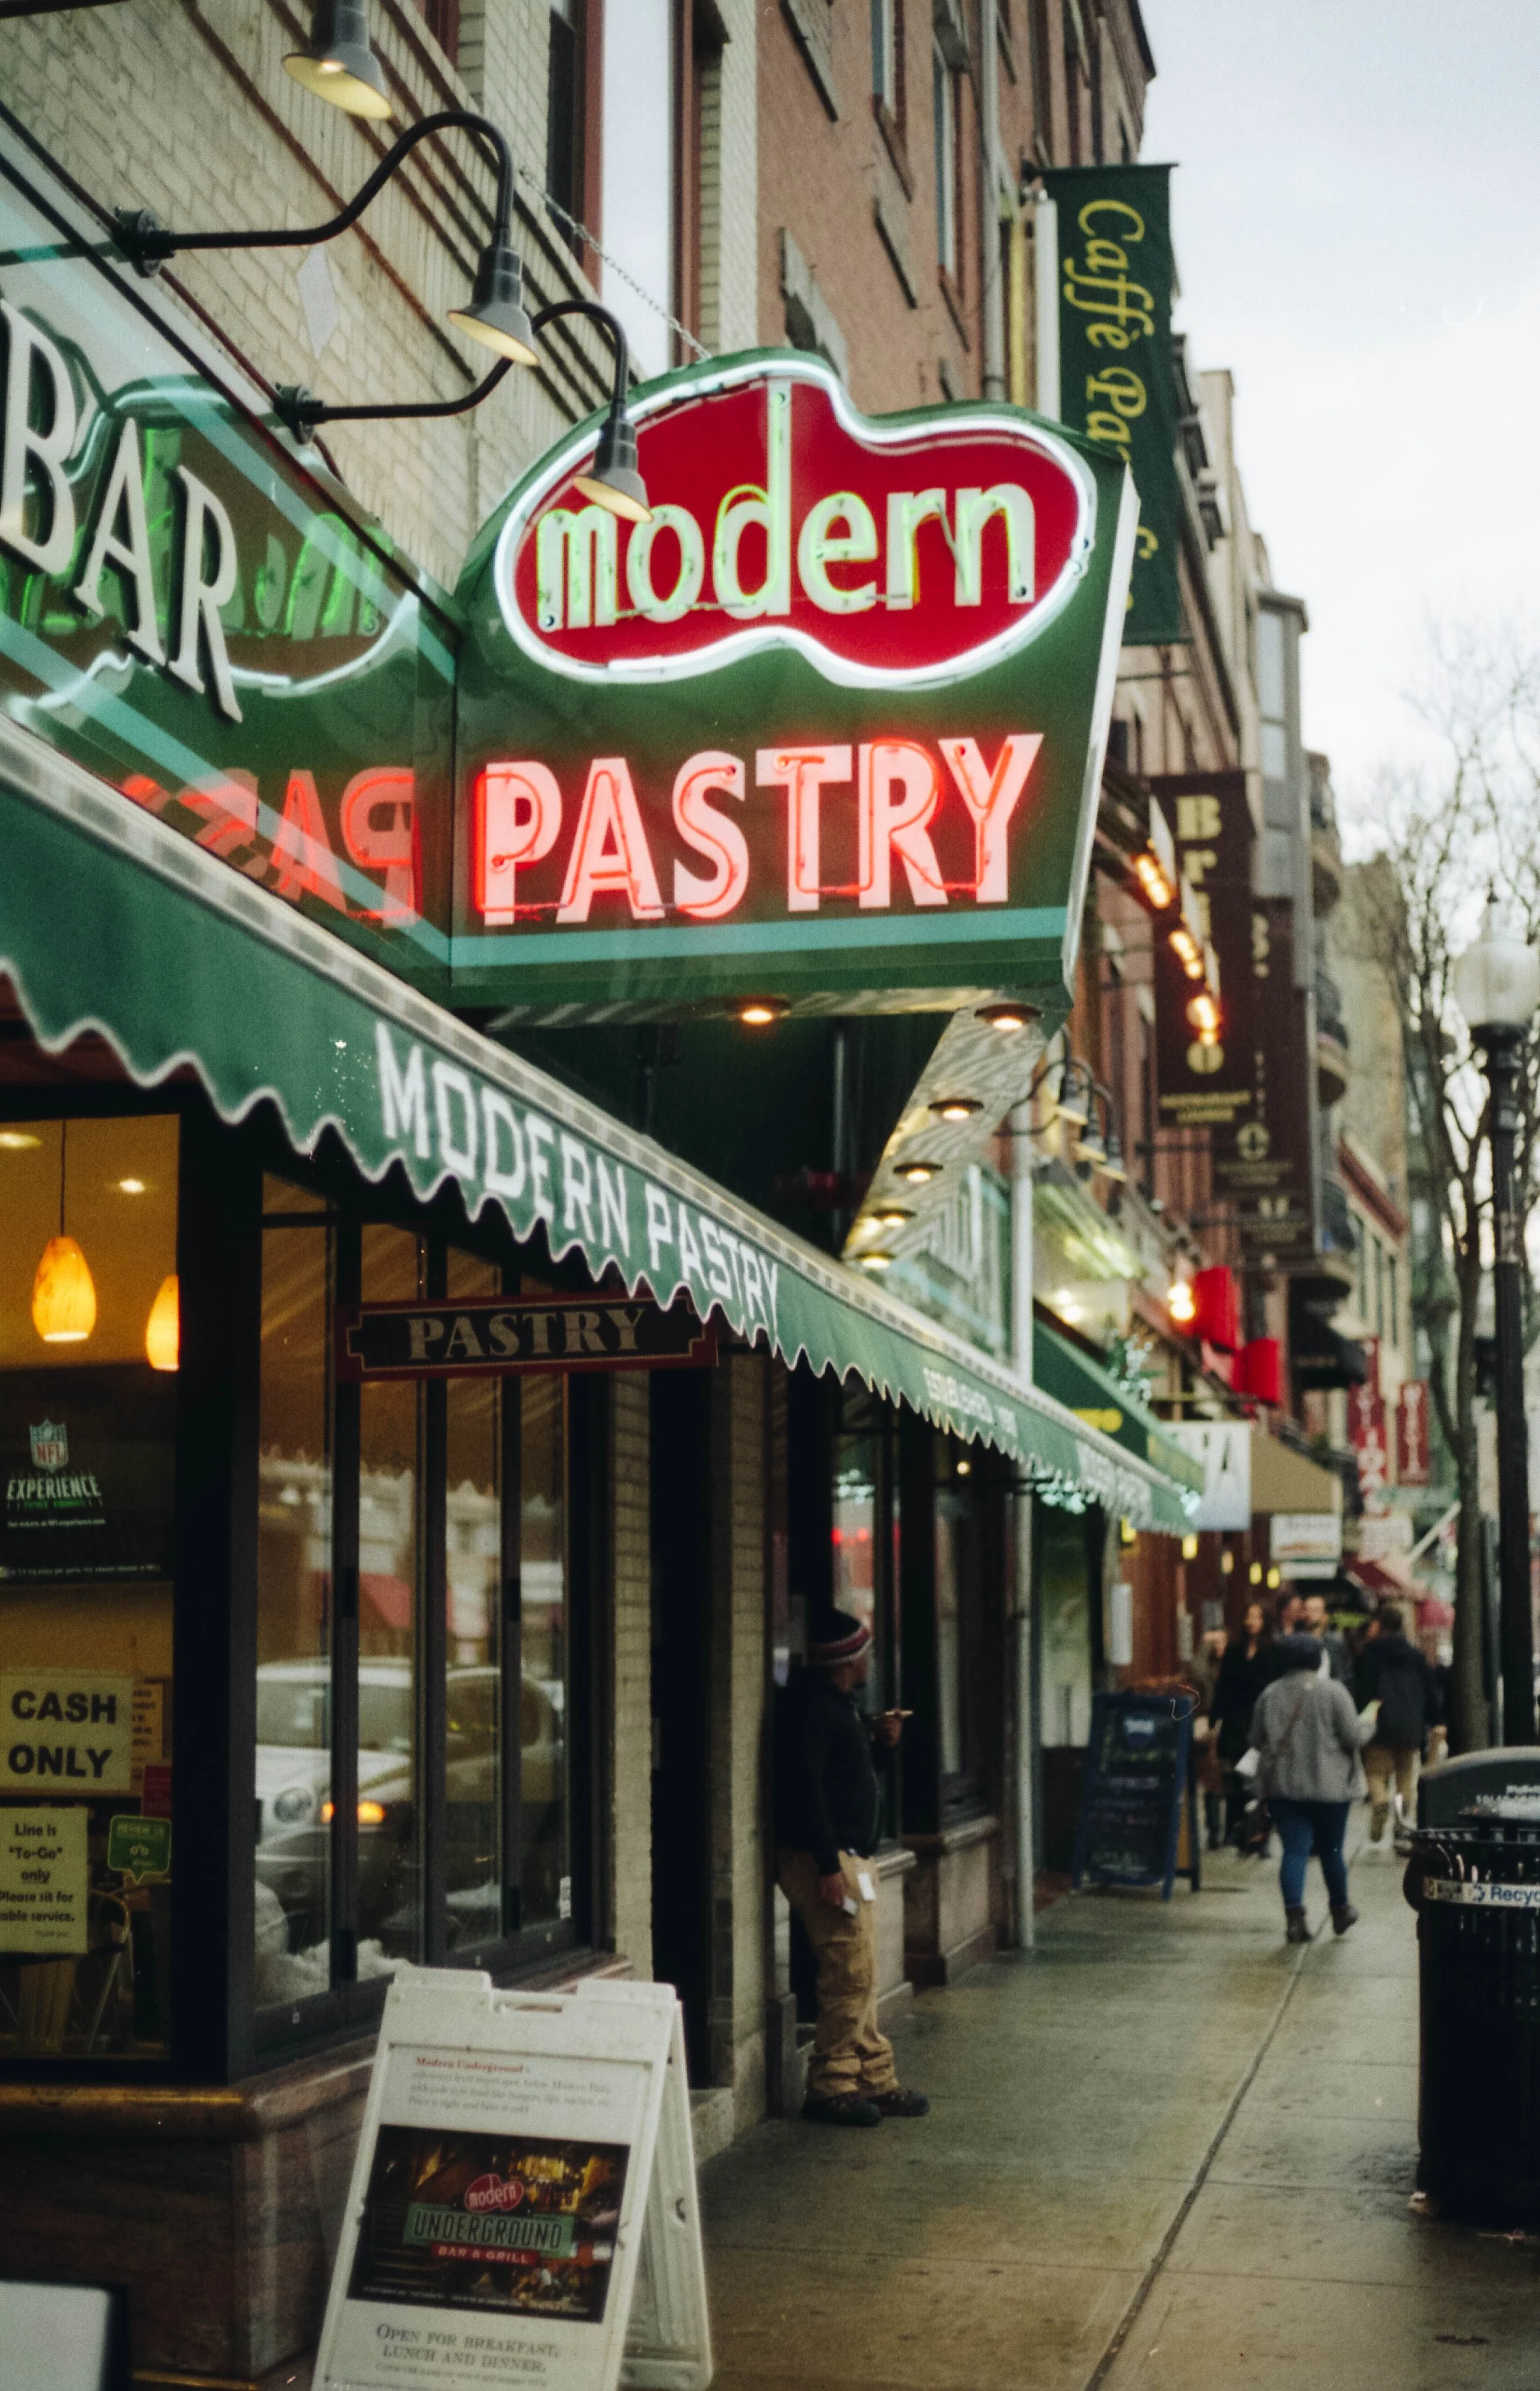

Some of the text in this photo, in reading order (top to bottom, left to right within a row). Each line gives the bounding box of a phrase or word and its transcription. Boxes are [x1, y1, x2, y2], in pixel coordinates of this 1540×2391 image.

[0, 298, 242, 722] BAR
[537, 380, 1035, 632] modern
[477, 733, 1044, 926] PASTRY
[375, 1022, 779, 1329] MODERN PASTRY
[406, 1308, 646, 1360] PASTRY
[36, 1443, 64, 1464] NFL
[7, 1476, 102, 1501] EXPERIENCE
[11, 1689, 117, 1724] CASH
[8, 1744, 113, 1779] ONLY
[14, 1823, 57, 1837] Line is
[9, 1846, 63, 1860] "To-Go"
[20, 1868, 51, 1883] only
[56, 1891, 74, 1902] for
[31, 1912, 75, 1922] service.
[416, 2056, 524, 2072] Modern Underground
[469, 2175, 517, 2207] modern
[414, 2210, 562, 2249] UNDERGROUND
[438, 2246, 530, 2264] BAR & GRILL
[428, 2331, 457, 2347] FOR
[383, 2344, 436, 2362] LUNCH
[442, 2351, 476, 2366] AND
